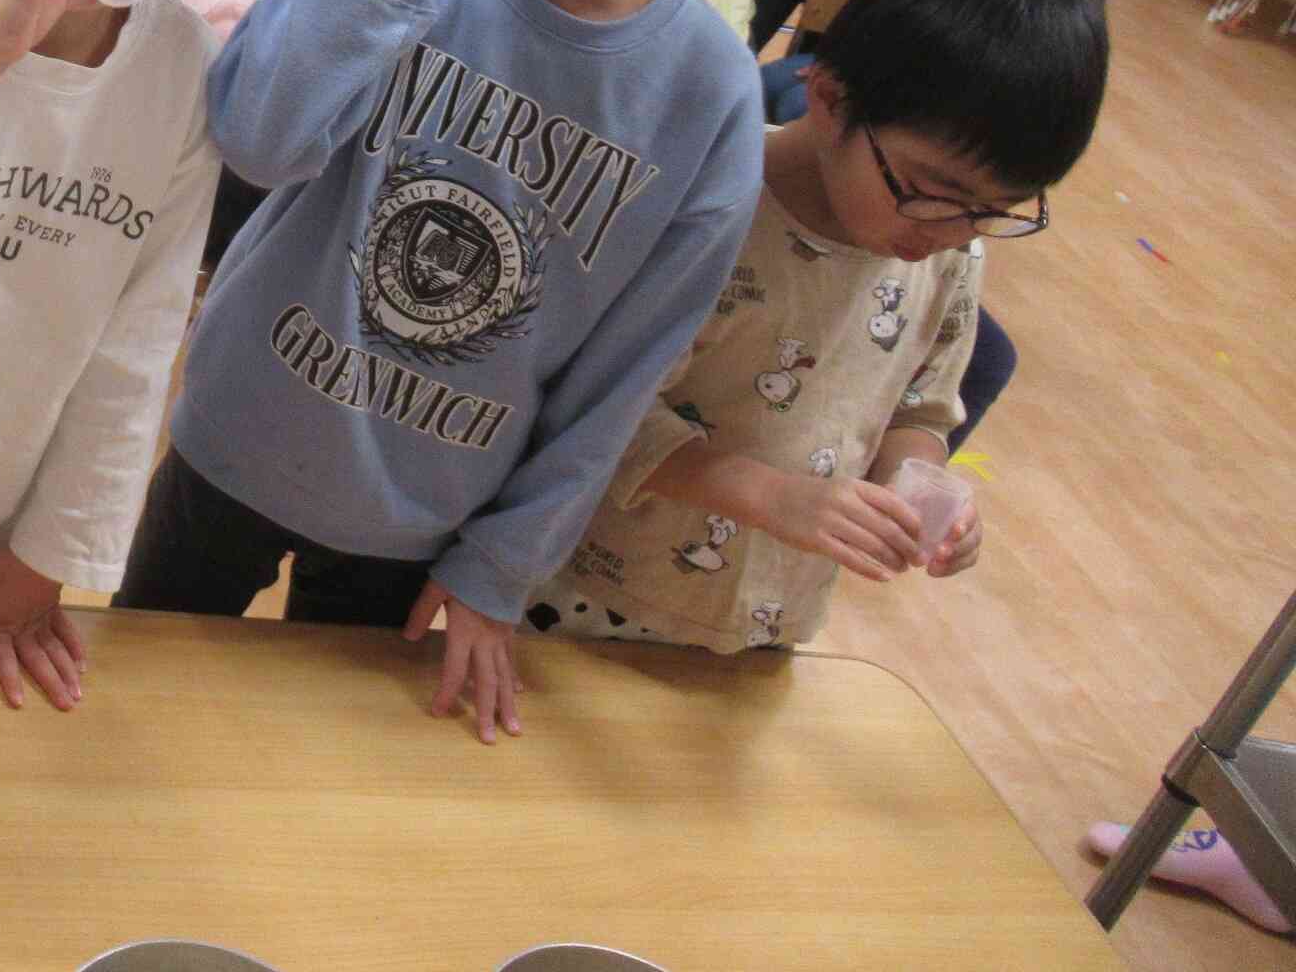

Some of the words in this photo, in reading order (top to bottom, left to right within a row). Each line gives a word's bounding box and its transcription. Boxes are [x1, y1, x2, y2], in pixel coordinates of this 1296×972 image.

[13, 214, 76, 247] EVERY
[447, 188, 516, 278] FAIRFIELD
[385, 281, 448, 319] ACADEMY
